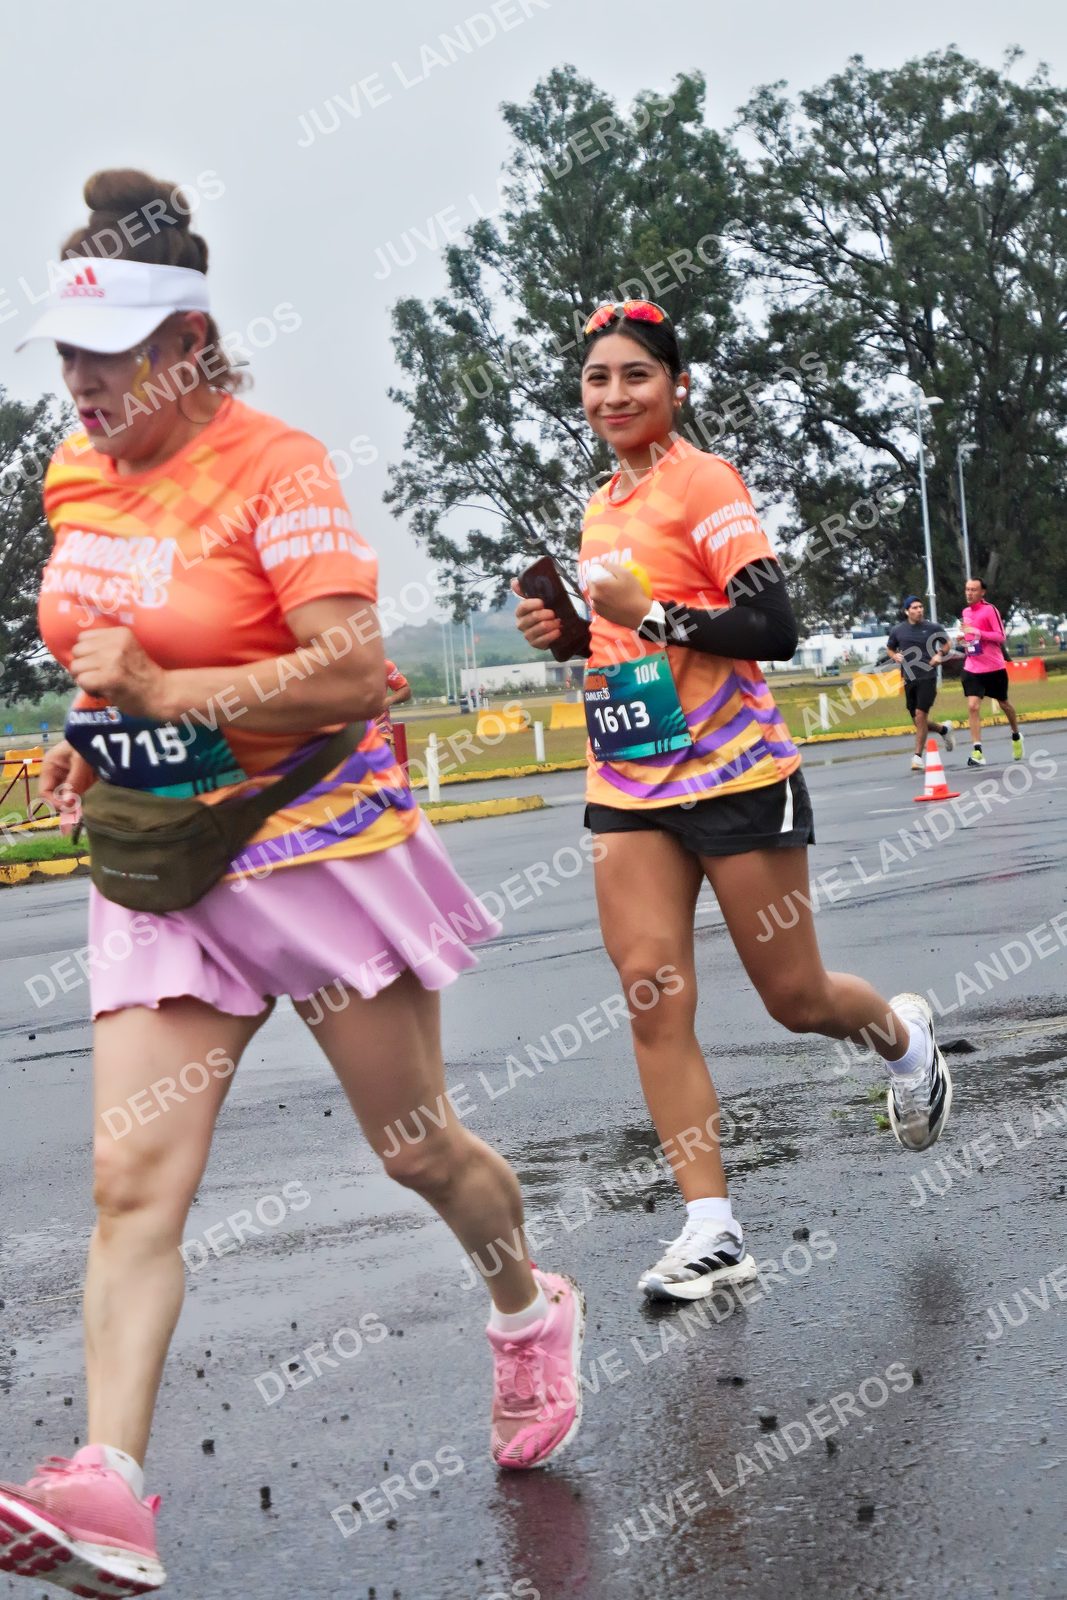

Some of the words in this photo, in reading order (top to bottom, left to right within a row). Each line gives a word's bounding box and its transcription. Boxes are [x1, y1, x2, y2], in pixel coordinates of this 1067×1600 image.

[633, 661, 660, 685] 10K
[594, 701, 651, 734] 1613
[91, 726, 188, 770] 1715
